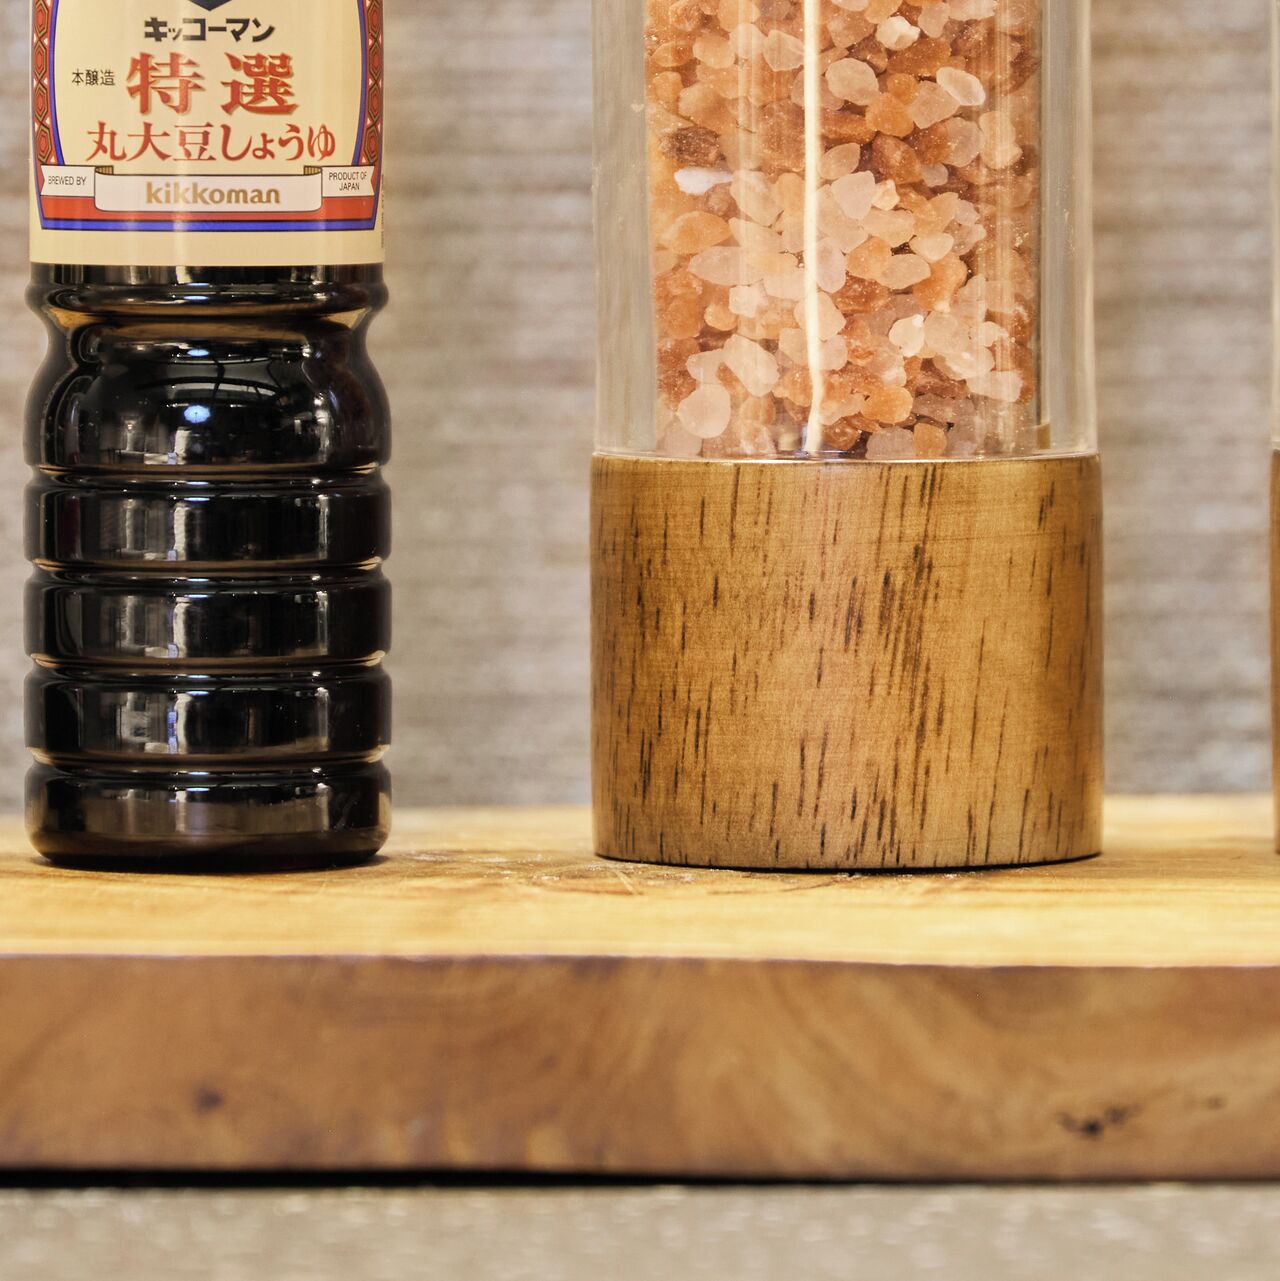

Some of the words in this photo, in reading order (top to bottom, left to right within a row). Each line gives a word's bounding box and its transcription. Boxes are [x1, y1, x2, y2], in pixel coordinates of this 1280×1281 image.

[143, 16, 276, 43] キッコーマン
[71, 68, 116, 87] 本醸造
[126, 51, 300, 117] 特選
[86, 121, 337, 163] 丸大豆しょうゆ
[48, 175, 74, 185] BREWED
[76, 175, 87, 186] BY
[329, 172, 359, 180] PRODUCT
[360, 171, 367, 180] OF
[339, 182, 360, 191] JAPAN
[145, 180, 281, 206] kikkoman
